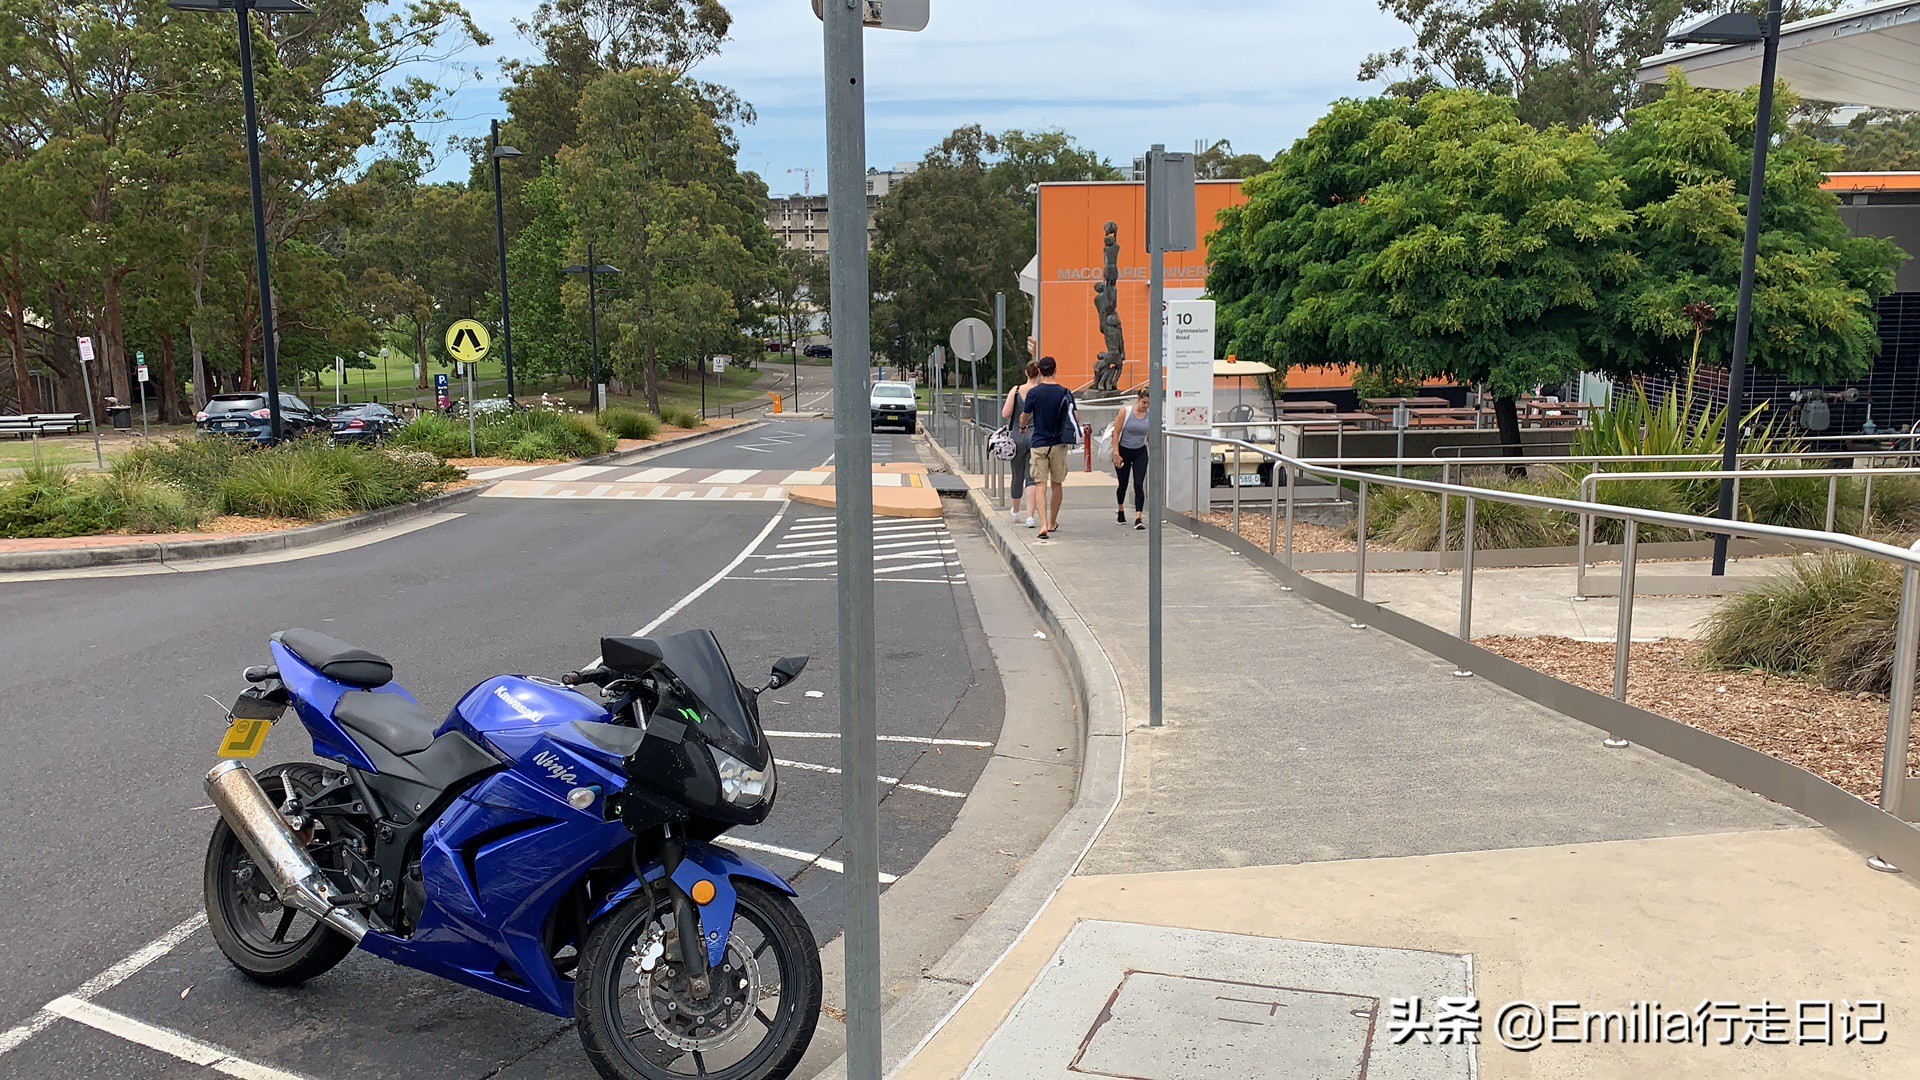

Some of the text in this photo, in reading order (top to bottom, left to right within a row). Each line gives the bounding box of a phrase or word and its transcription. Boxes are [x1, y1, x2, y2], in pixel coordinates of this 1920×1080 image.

[1058, 265, 1212, 280] MACQARIE NIVER
[1177, 313, 1192, 325] 10
[438, 375, 446, 385] P
[493, 685, 545, 723] Kawasaki
[533, 750, 578, 785] Ninja
